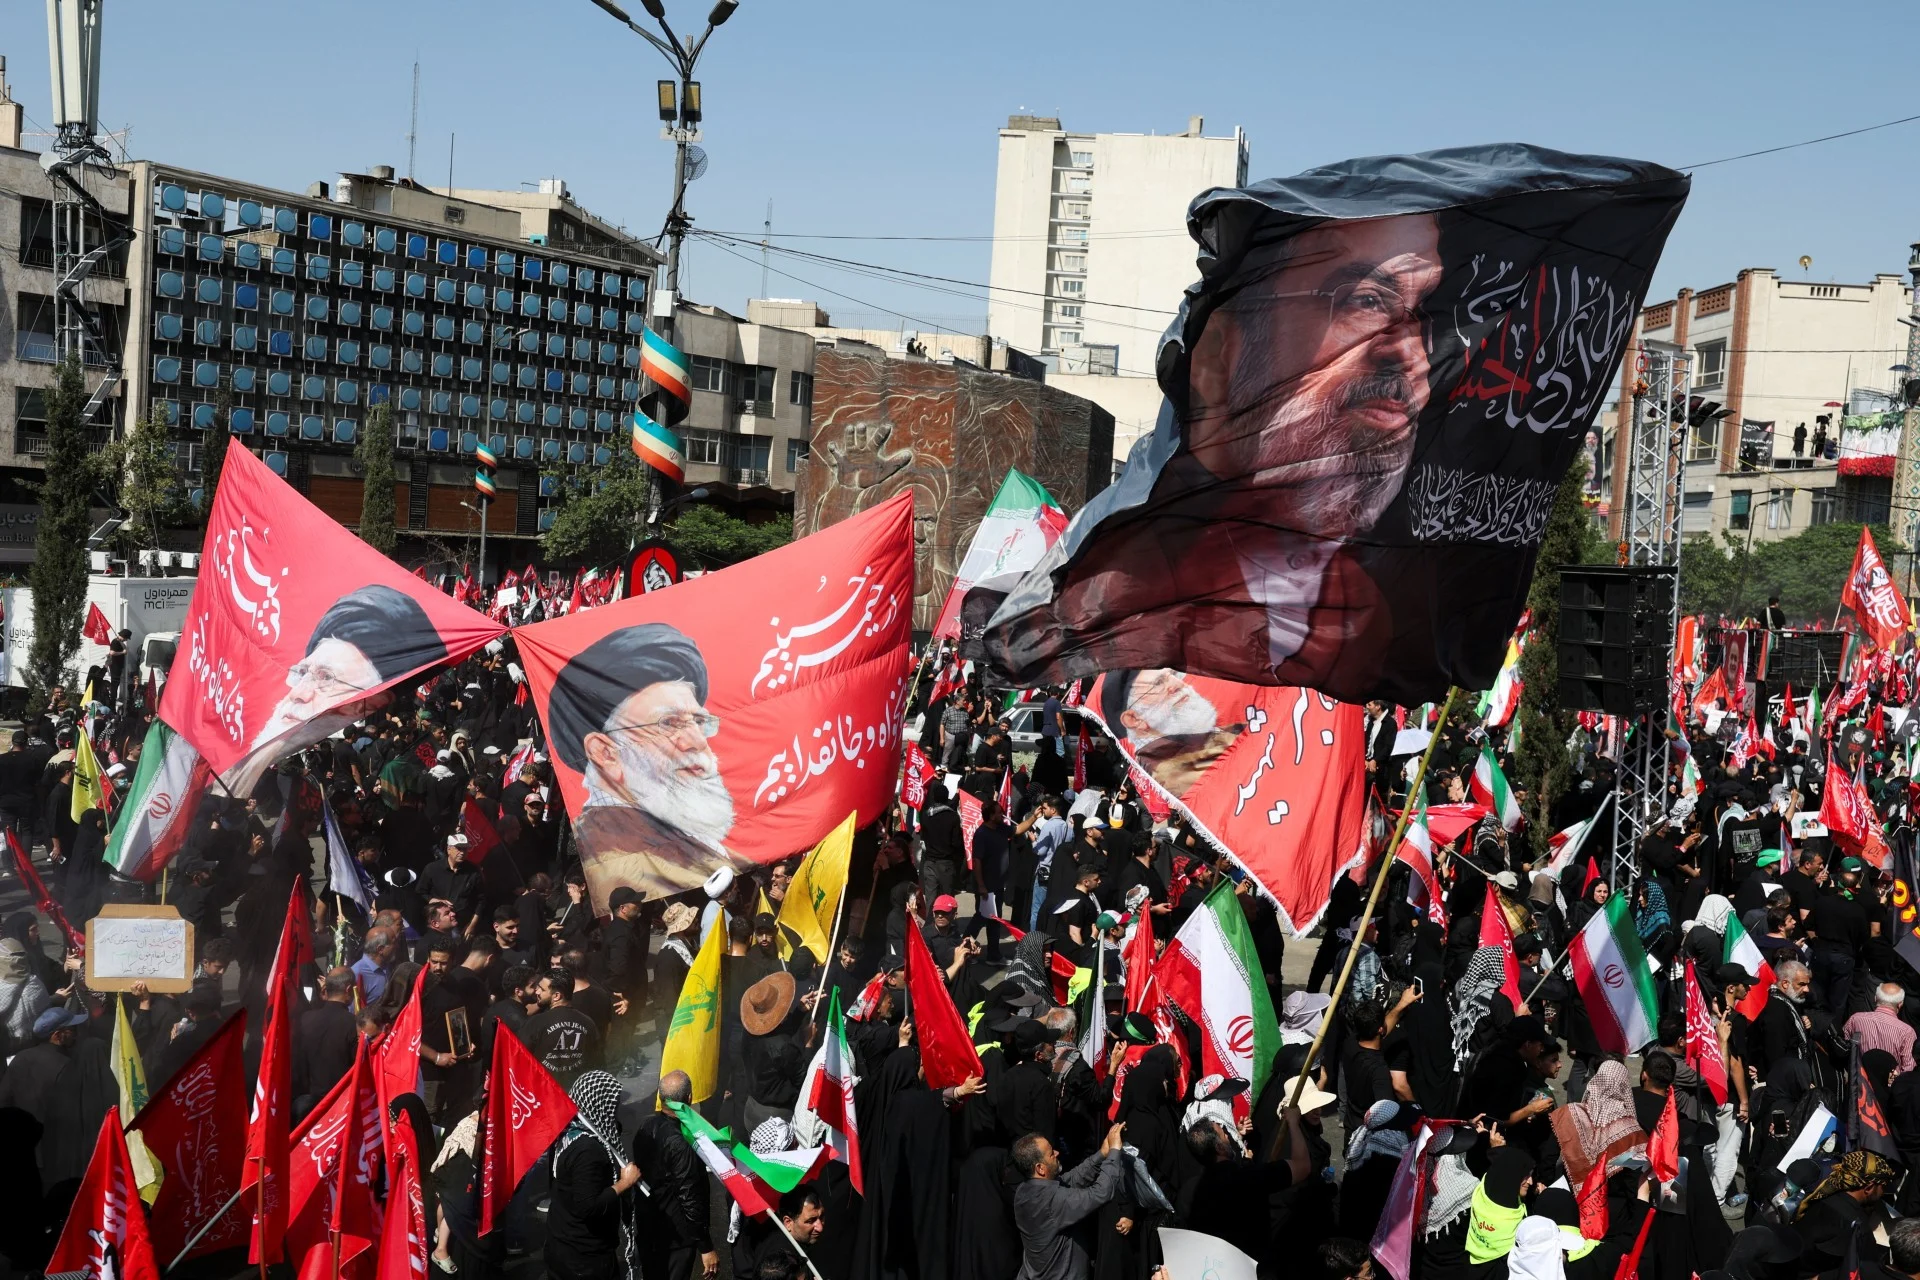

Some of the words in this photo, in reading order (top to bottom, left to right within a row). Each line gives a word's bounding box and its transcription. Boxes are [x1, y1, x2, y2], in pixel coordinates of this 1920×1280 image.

[16, 532, 38, 542] Ban
[144, 598, 165, 610] mci
[547, 1021, 571, 1035] ARMANI
